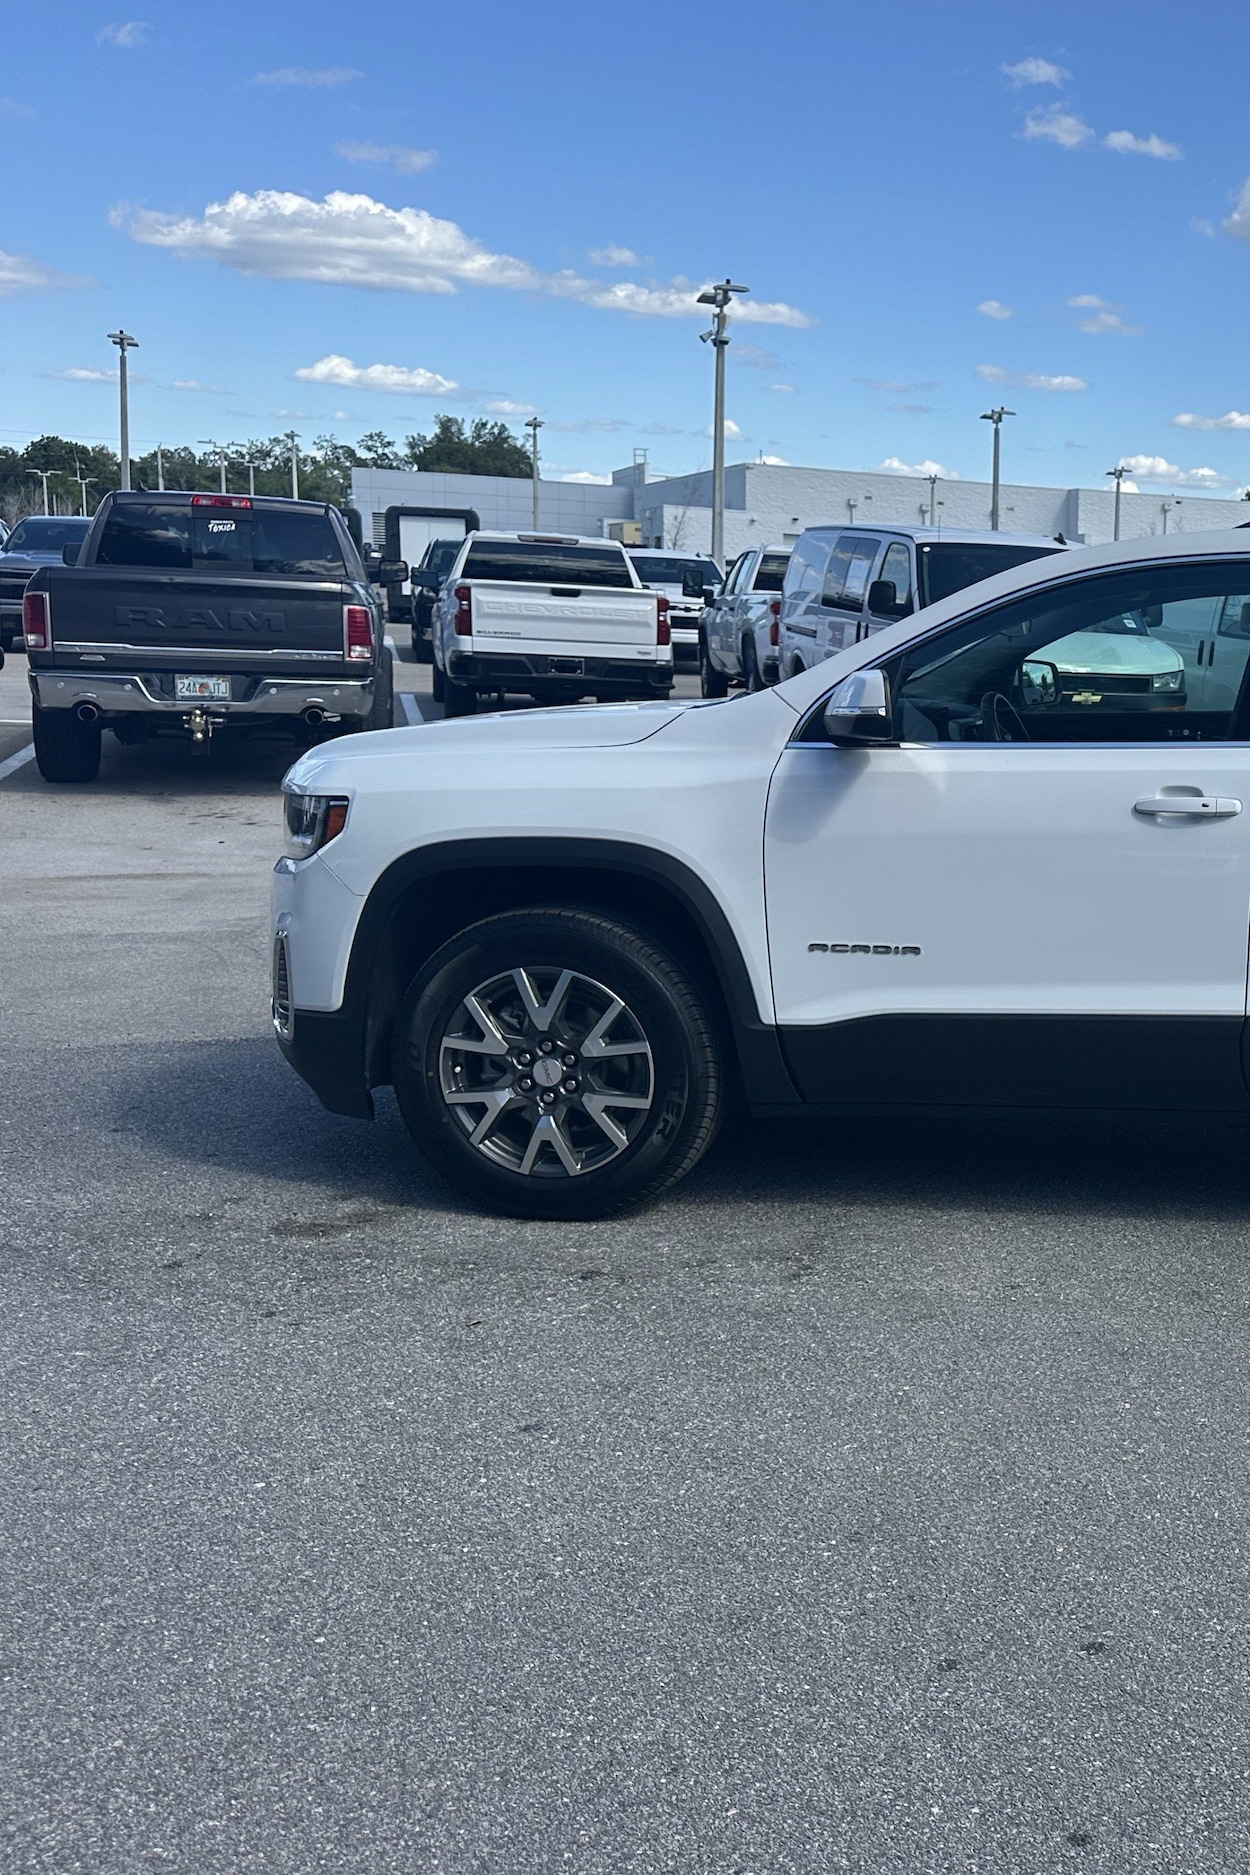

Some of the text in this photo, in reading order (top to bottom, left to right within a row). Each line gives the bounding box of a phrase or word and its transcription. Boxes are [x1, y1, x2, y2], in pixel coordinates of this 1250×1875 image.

[208, 523, 236, 532] TOXICA
[486, 601, 646, 620] CHEVROLET
[114, 605, 286, 633] RAM
[179, 681, 197, 694] 24A
[808, 943, 921, 956] ACADIA
[541, 1060, 554, 1085] GMC
